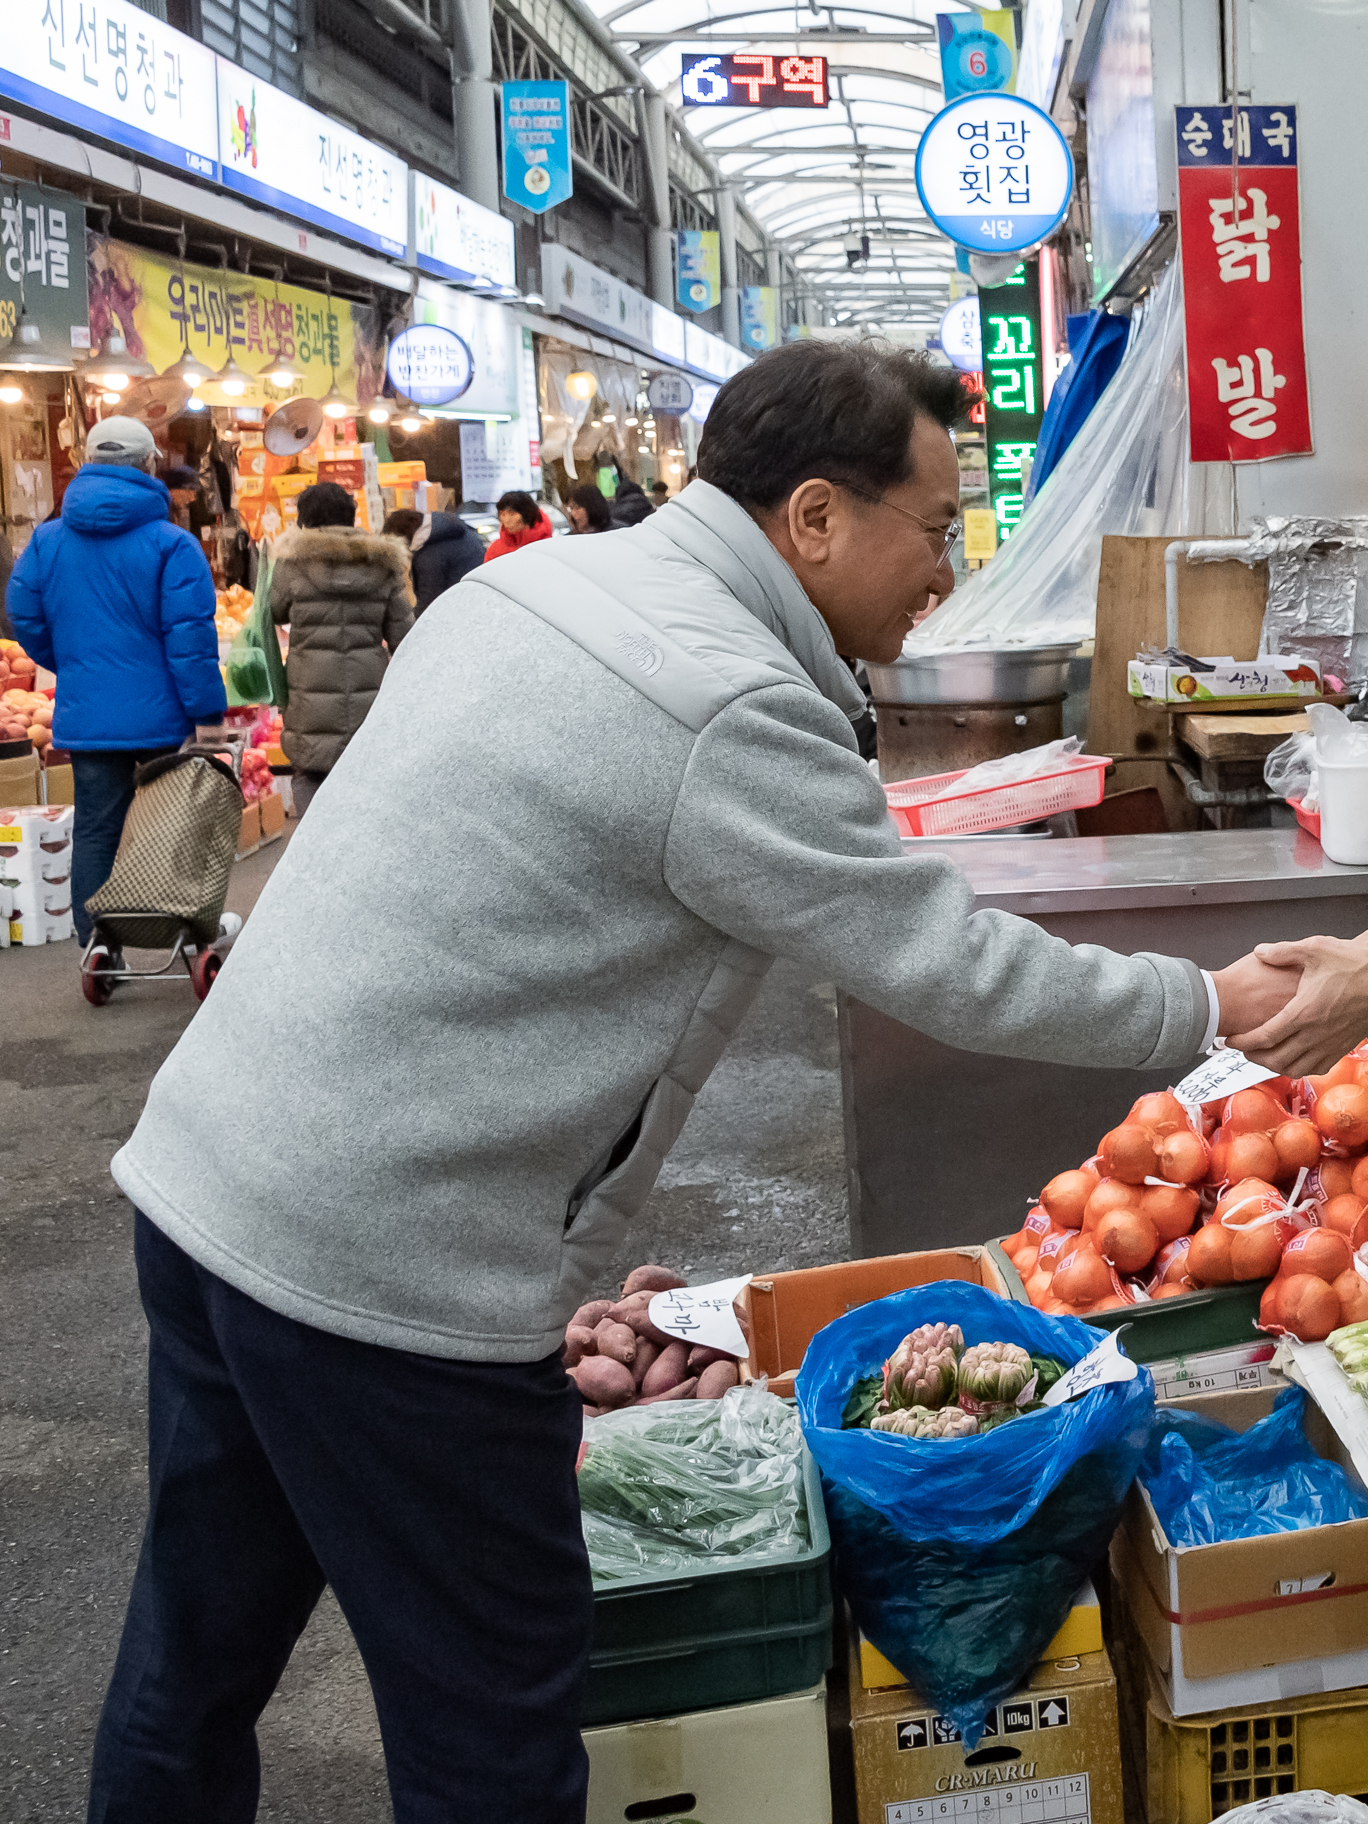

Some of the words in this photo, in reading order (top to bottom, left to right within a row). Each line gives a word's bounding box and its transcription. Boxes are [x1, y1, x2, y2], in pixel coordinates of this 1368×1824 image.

[682, 55, 827, 105] 6구역
[968, 51, 988, 76] 6
[957, 120, 1031, 160] 영광
[1182, 111, 1294, 158] 순대국
[318, 134, 393, 217] 진선명청과
[958, 165, 1031, 205] 횟집
[979, 219, 1014, 240] 식당
[1208, 187, 1287, 441] 닭발
[397, 344, 459, 361] 배달하는
[398, 364, 461, 381] 반찬가게
[987, 316, 1037, 414] 꼬리
[1239, 1369, 1258, 1381] 무게
[1006, 1711, 1030, 1728] 10kg
[894, 1809, 902, 1820] 4
[917, 1806, 924, 1817] 5
[940, 1803, 947, 1814] 6
[962, 1799, 969, 1810] 7
[983, 1796, 991, 1807] 8
[1005, 1792, 1013, 1803] 9
[1025, 1788, 1039, 1800] 10
[1048, 1784, 1060, 1797] 11
[1069, 1780, 1083, 1793] 12
